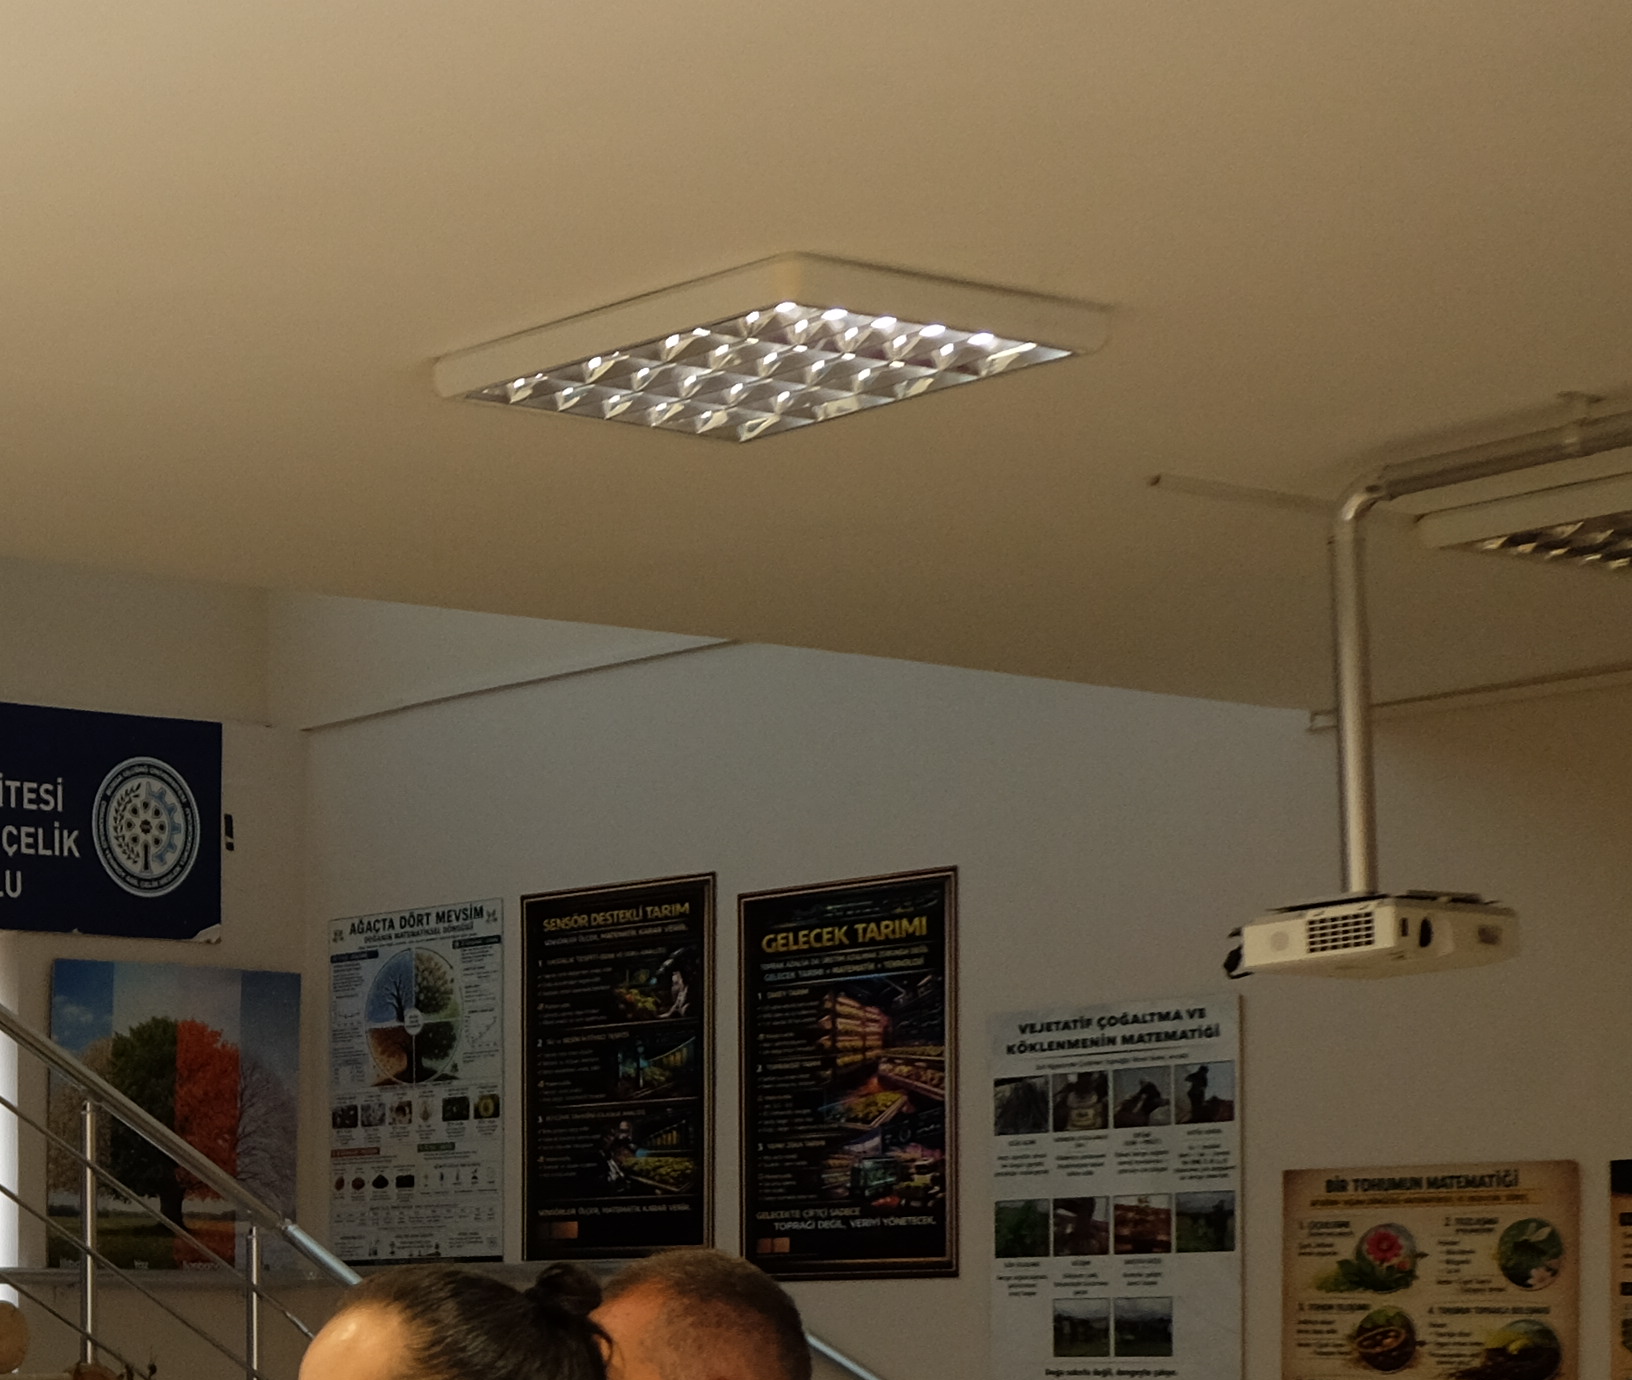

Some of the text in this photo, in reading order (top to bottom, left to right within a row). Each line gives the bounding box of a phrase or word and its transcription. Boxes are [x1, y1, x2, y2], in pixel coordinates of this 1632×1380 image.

[0, 824, 81, 861] ÇELİK
[349, 903, 485, 937] AĞAÇTA DÖRT MEVSİM
[543, 901, 691, 932] SENSÖR DESTEKLİ TARIM
[761, 915, 928, 954] GELECEK TARIMI
[1017, 1006, 1207, 1036] VEJETATİF ÇOĞALTMA VE
[1005, 1022, 1221, 1056] KÖKLENMENİN MATEMATİĞİ
[1324, 1168, 1520, 1193] BİR TOHUMUN MATEMATİĞİ
